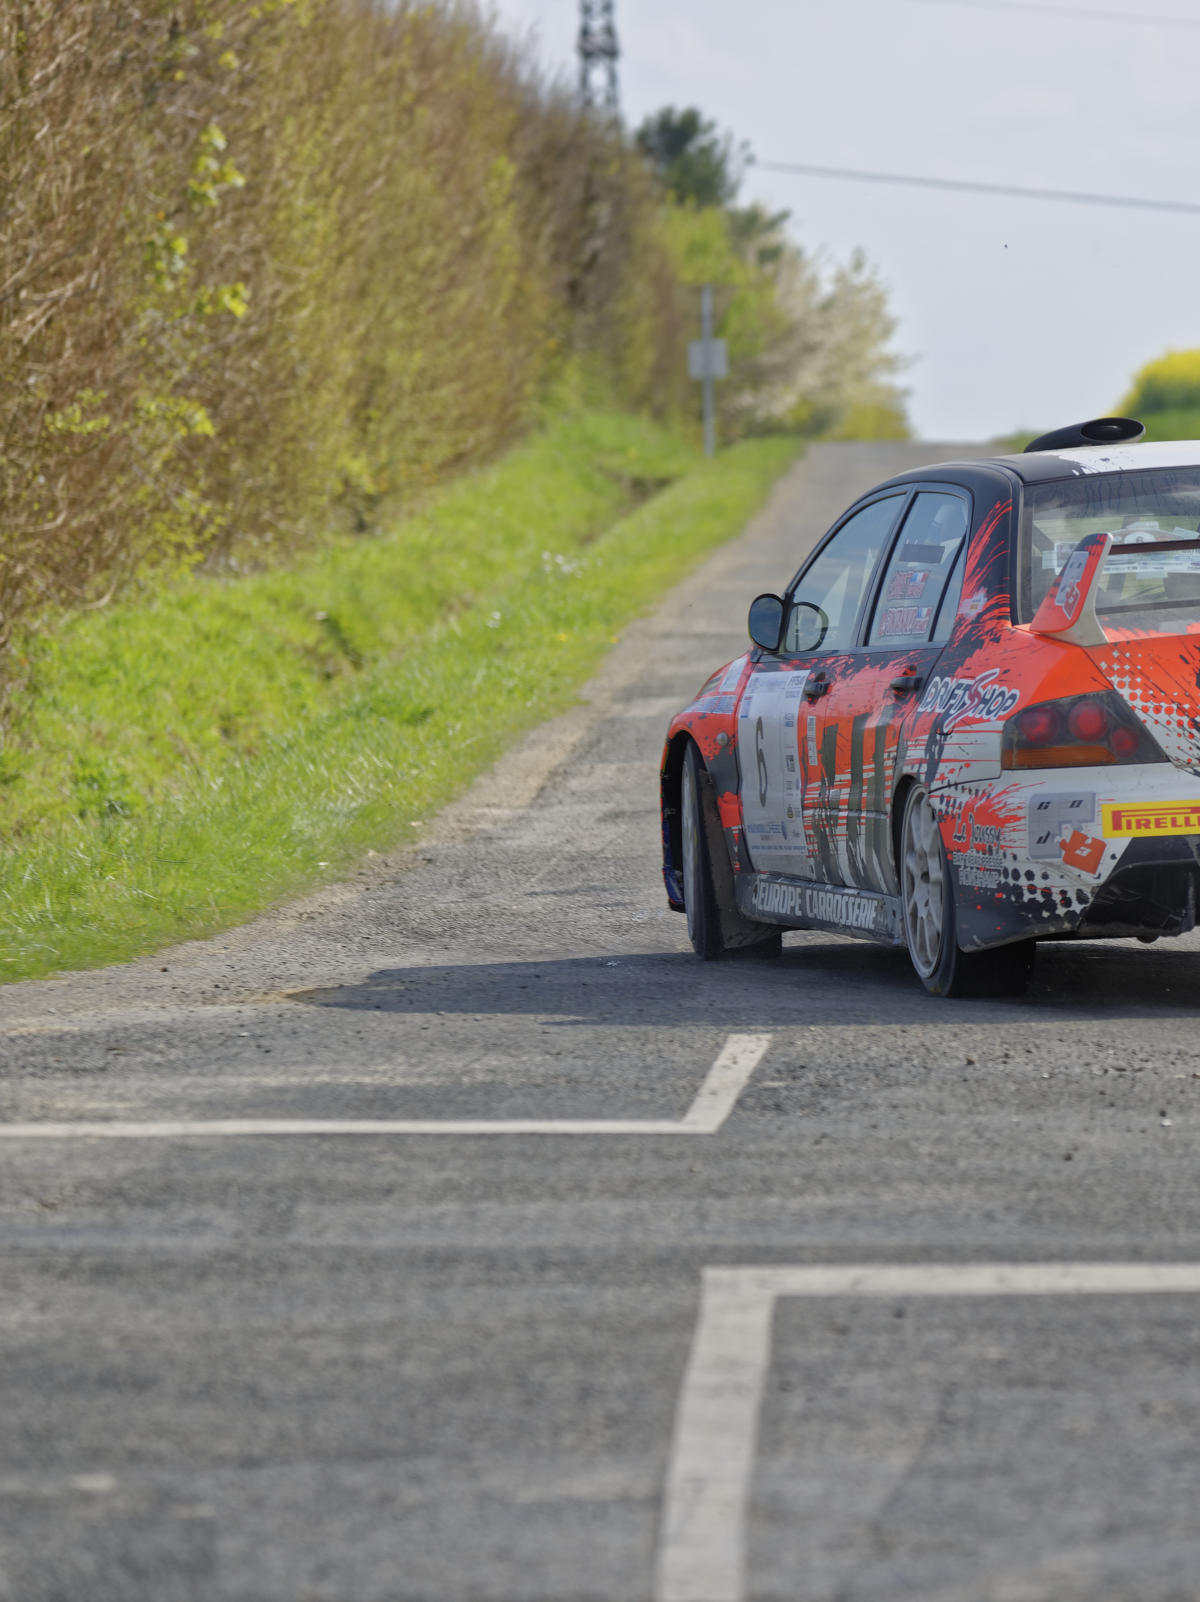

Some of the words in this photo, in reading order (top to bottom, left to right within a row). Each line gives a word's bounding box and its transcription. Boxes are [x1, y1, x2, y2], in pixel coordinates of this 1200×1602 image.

[756, 716, 768, 808] 6
[757, 881, 803, 916] EUROPE
[806, 889, 878, 930] CARROSSERIE
